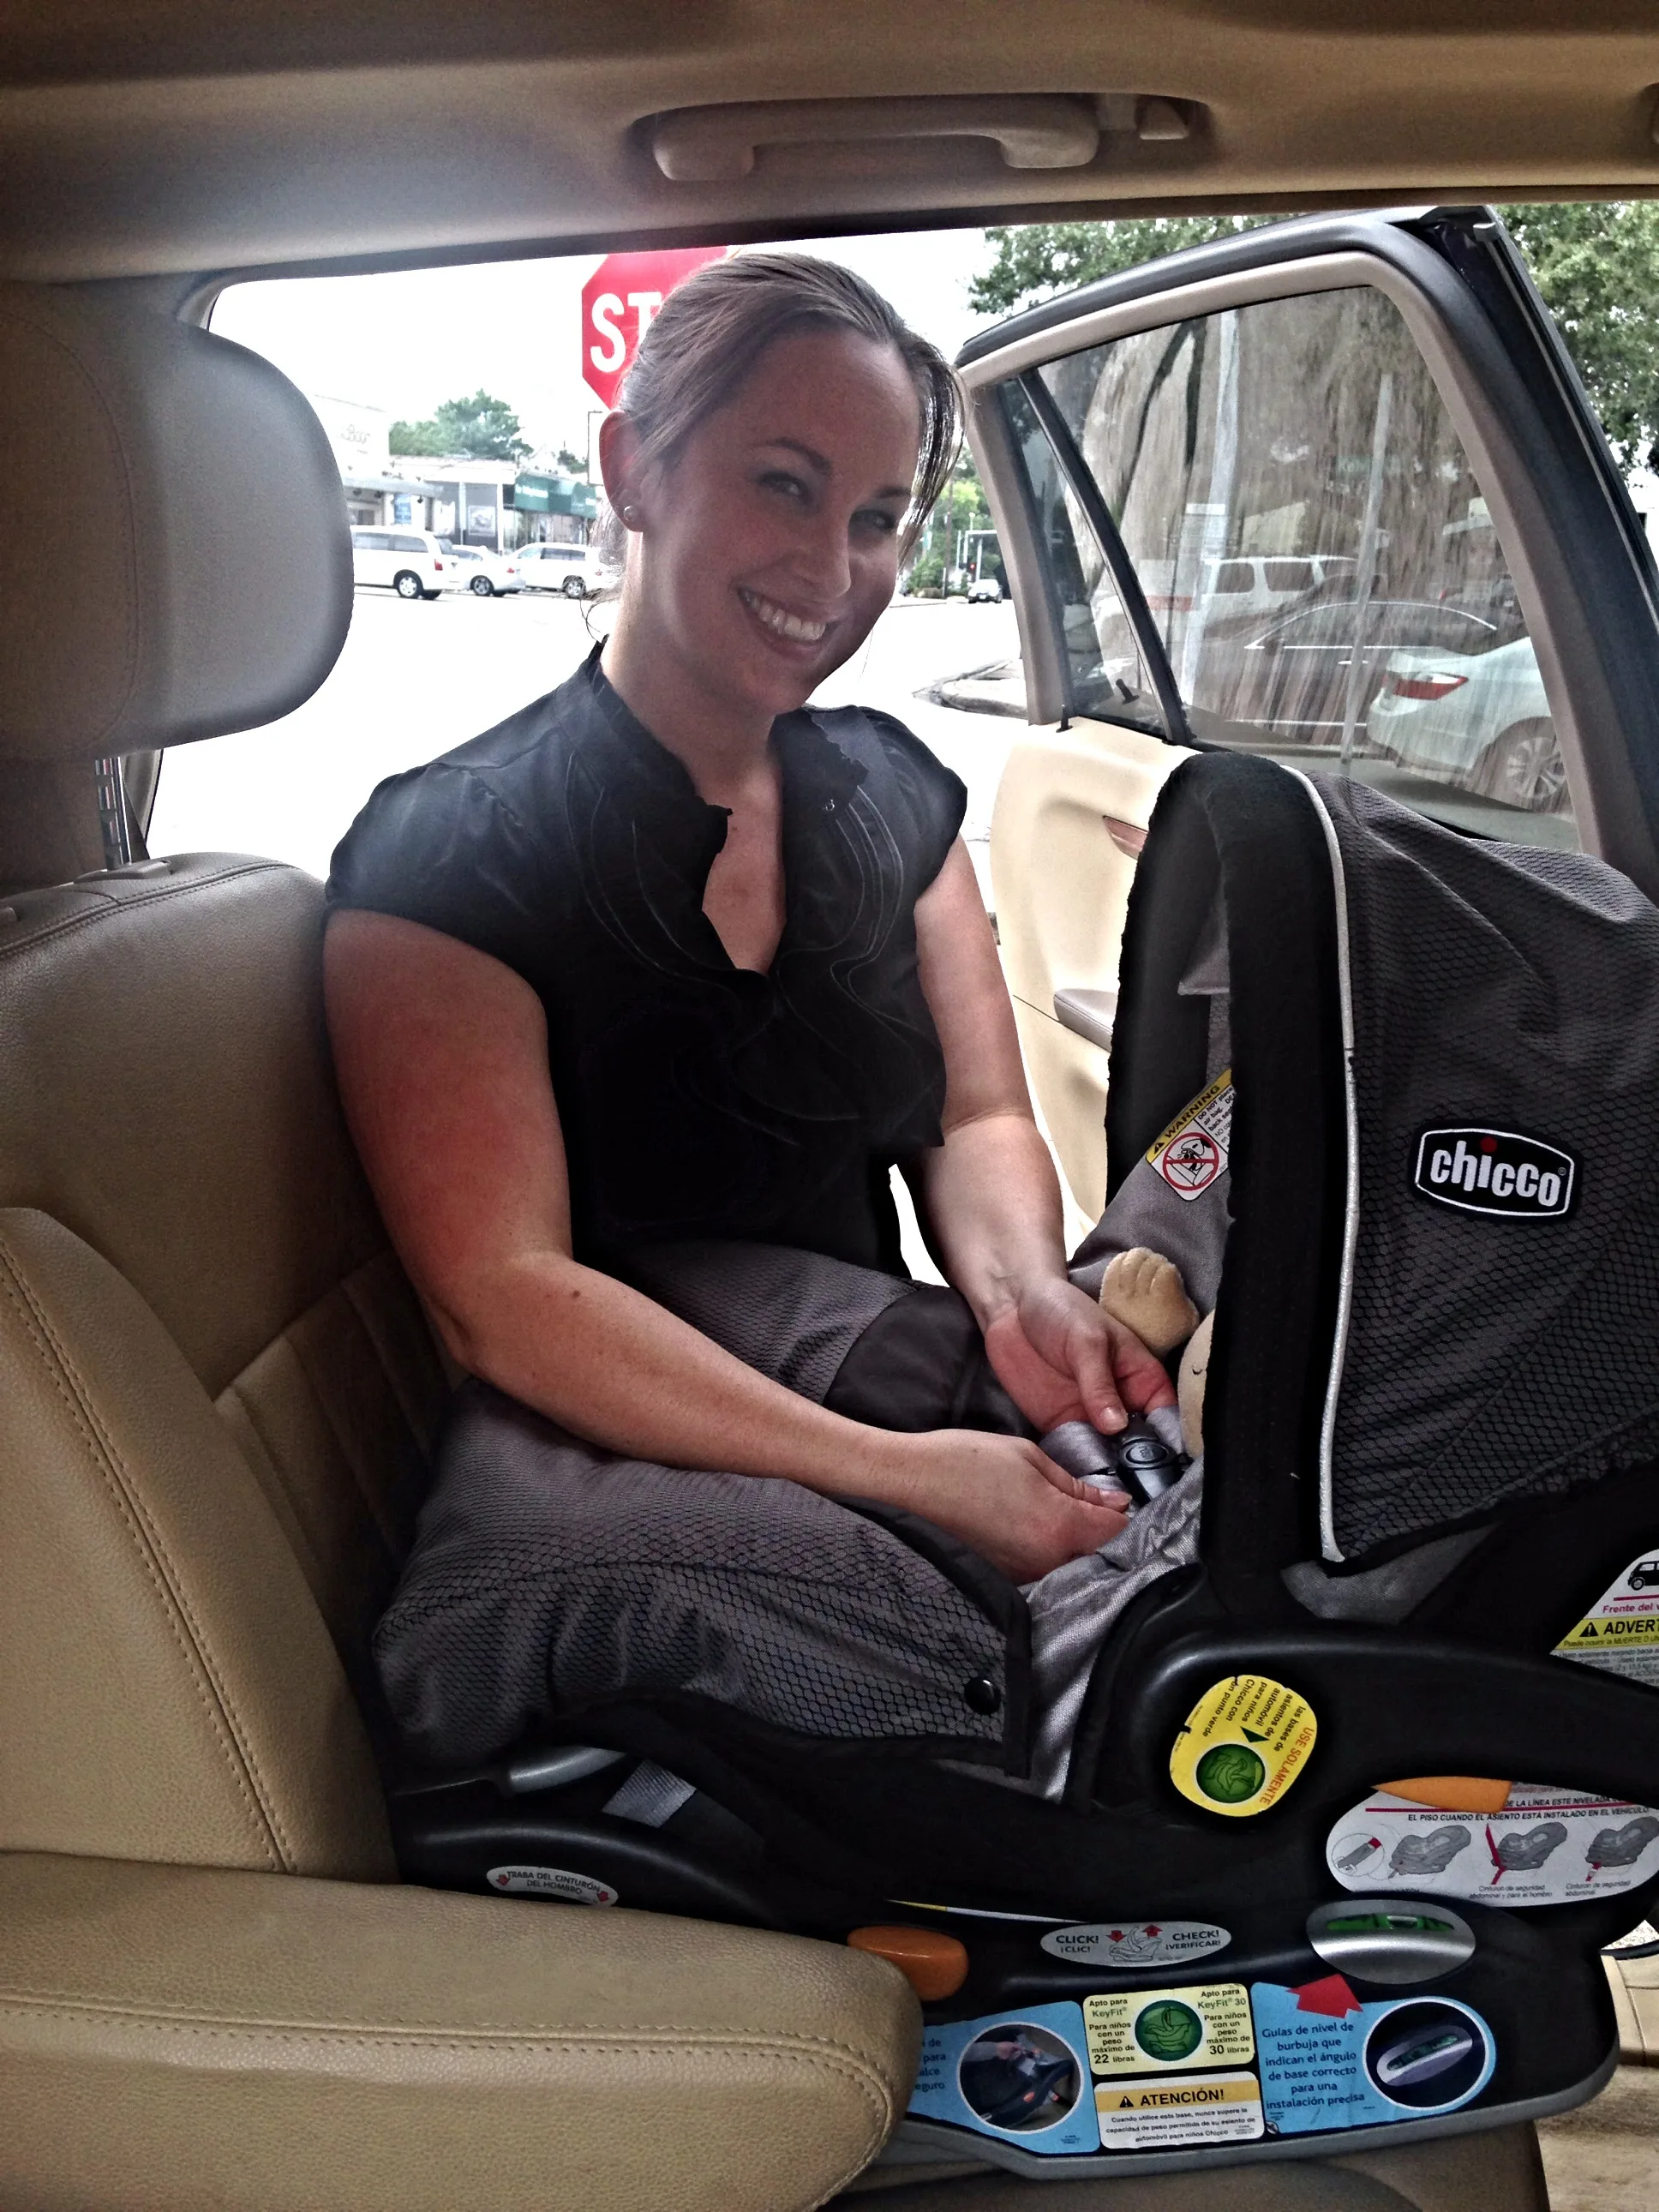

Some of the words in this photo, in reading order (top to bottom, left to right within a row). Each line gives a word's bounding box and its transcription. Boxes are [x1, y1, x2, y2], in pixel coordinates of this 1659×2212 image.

[590, 291, 662, 373] ST
[1165, 1085, 1220, 1138] WARNING
[1198, 1111, 1207, 1120] DO
[1207, 1100, 1218, 1112] NOT
[1208, 1118, 1223, 1131] back
[1430, 1136, 1561, 1207] chicco
[1602, 1604, 1636, 1613] Frente
[1638, 1603, 1654, 1611] del
[1235, 1678, 1255, 1705] Chicco
[1255, 1681, 1267, 1700] para
[1215, 1692, 1231, 1716] punto
[1255, 1687, 1280, 1727] automóvil
[1271, 1693, 1292, 1726] asientos
[1294, 1705, 1306, 1717] las
[1225, 1706, 1238, 1722] con
[1242, 1700, 1257, 1723] niños
[1202, 1716, 1218, 1737] verde
[1264, 1727, 1275, 1737] de
[1279, 1719, 1299, 1741] bases
[1295, 1727, 1314, 1747] USE
[1273, 1741, 1284, 1752] de
[1259, 1747, 1302, 1806] SOLAMENTE
[1487, 1813, 1521, 1821] ASIENTO
[1544, 1810, 1587, 1819] INSTALADO
[543, 1881, 583, 1895] HOMBRO
[555, 1874, 600, 1892] CINTURÓN
[1056, 1934, 1099, 1944] CLICK!
[1172, 1930, 1219, 1941] CHECK!
[1222, 1988, 1240, 1997] para
[1218, 2029, 1237, 2037] peso
[1295, 2025, 1309, 2035] de
[1312, 2023, 1338, 2033] nivel
[1340, 2022, 1354, 2031] de
[928, 2038, 942, 2047] de
[1102, 2038, 1123, 2047] peso
[1209, 2044, 1225, 2054] 30
[1277, 2040, 1319, 2051] burbuja
[1321, 2039, 1342, 2049] que
[923, 2053, 947, 2065] para
[1094, 2053, 1110, 2064] 22
[1266, 2055, 1304, 2066] indican
[1307, 2053, 1317, 2063] el
[1320, 2052, 1357, 2064] ángulo
[1268, 2071, 1282, 2081] de
[1285, 2070, 1309, 2080] base
[1312, 2066, 1357, 2077] correcto
[1291, 2084, 1315, 2095] para
[1317, 2083, 1338, 2091] una
[1140, 2088, 1225, 2107] ATENCIÓN!
[1266, 2096, 1325, 2109] instalación
[1327, 2092, 1365, 2107] precisa
[1105, 2125, 1140, 2134] capacidad
[1135, 2133, 1168, 2142] automóvil
